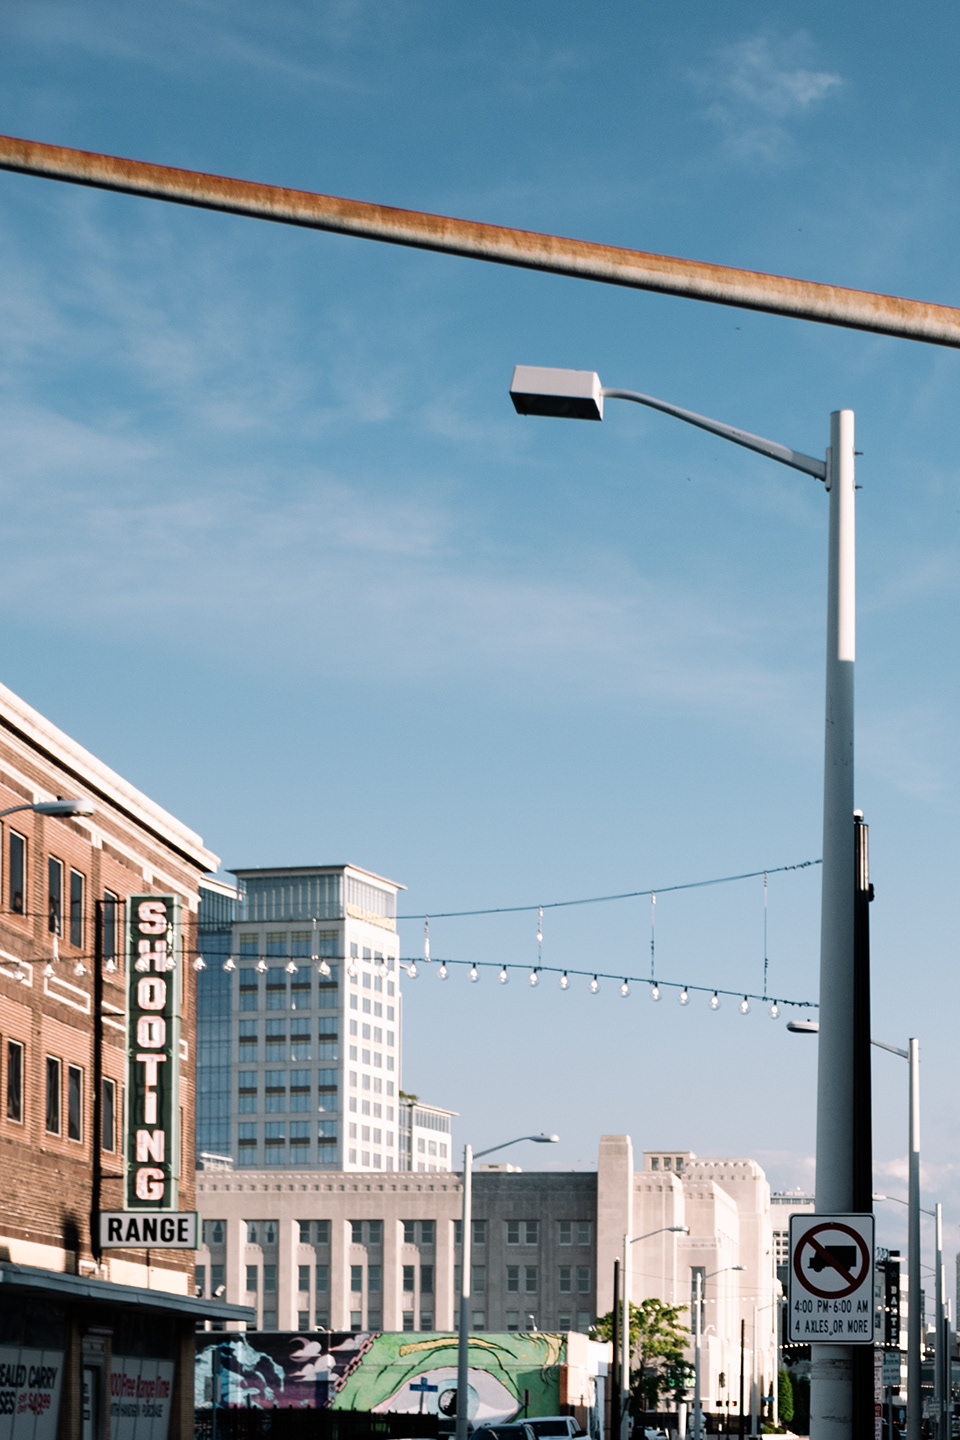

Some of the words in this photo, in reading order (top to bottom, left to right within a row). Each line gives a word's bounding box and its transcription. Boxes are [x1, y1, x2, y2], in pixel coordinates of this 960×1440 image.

[135, 901, 167, 1201] SHOOTING
[108, 1218, 189, 1243] RANGE
[794, 1300, 813, 1313] 4:00
[856, 1300, 868, 1313] AM
[795, 1320, 800, 1333] 4
[805, 1320, 828, 1333] AXLES
[833, 1320, 843, 1333] OR
[848, 1320, 868, 1333] MORE
[28, 1365, 58, 1389] CARRY
